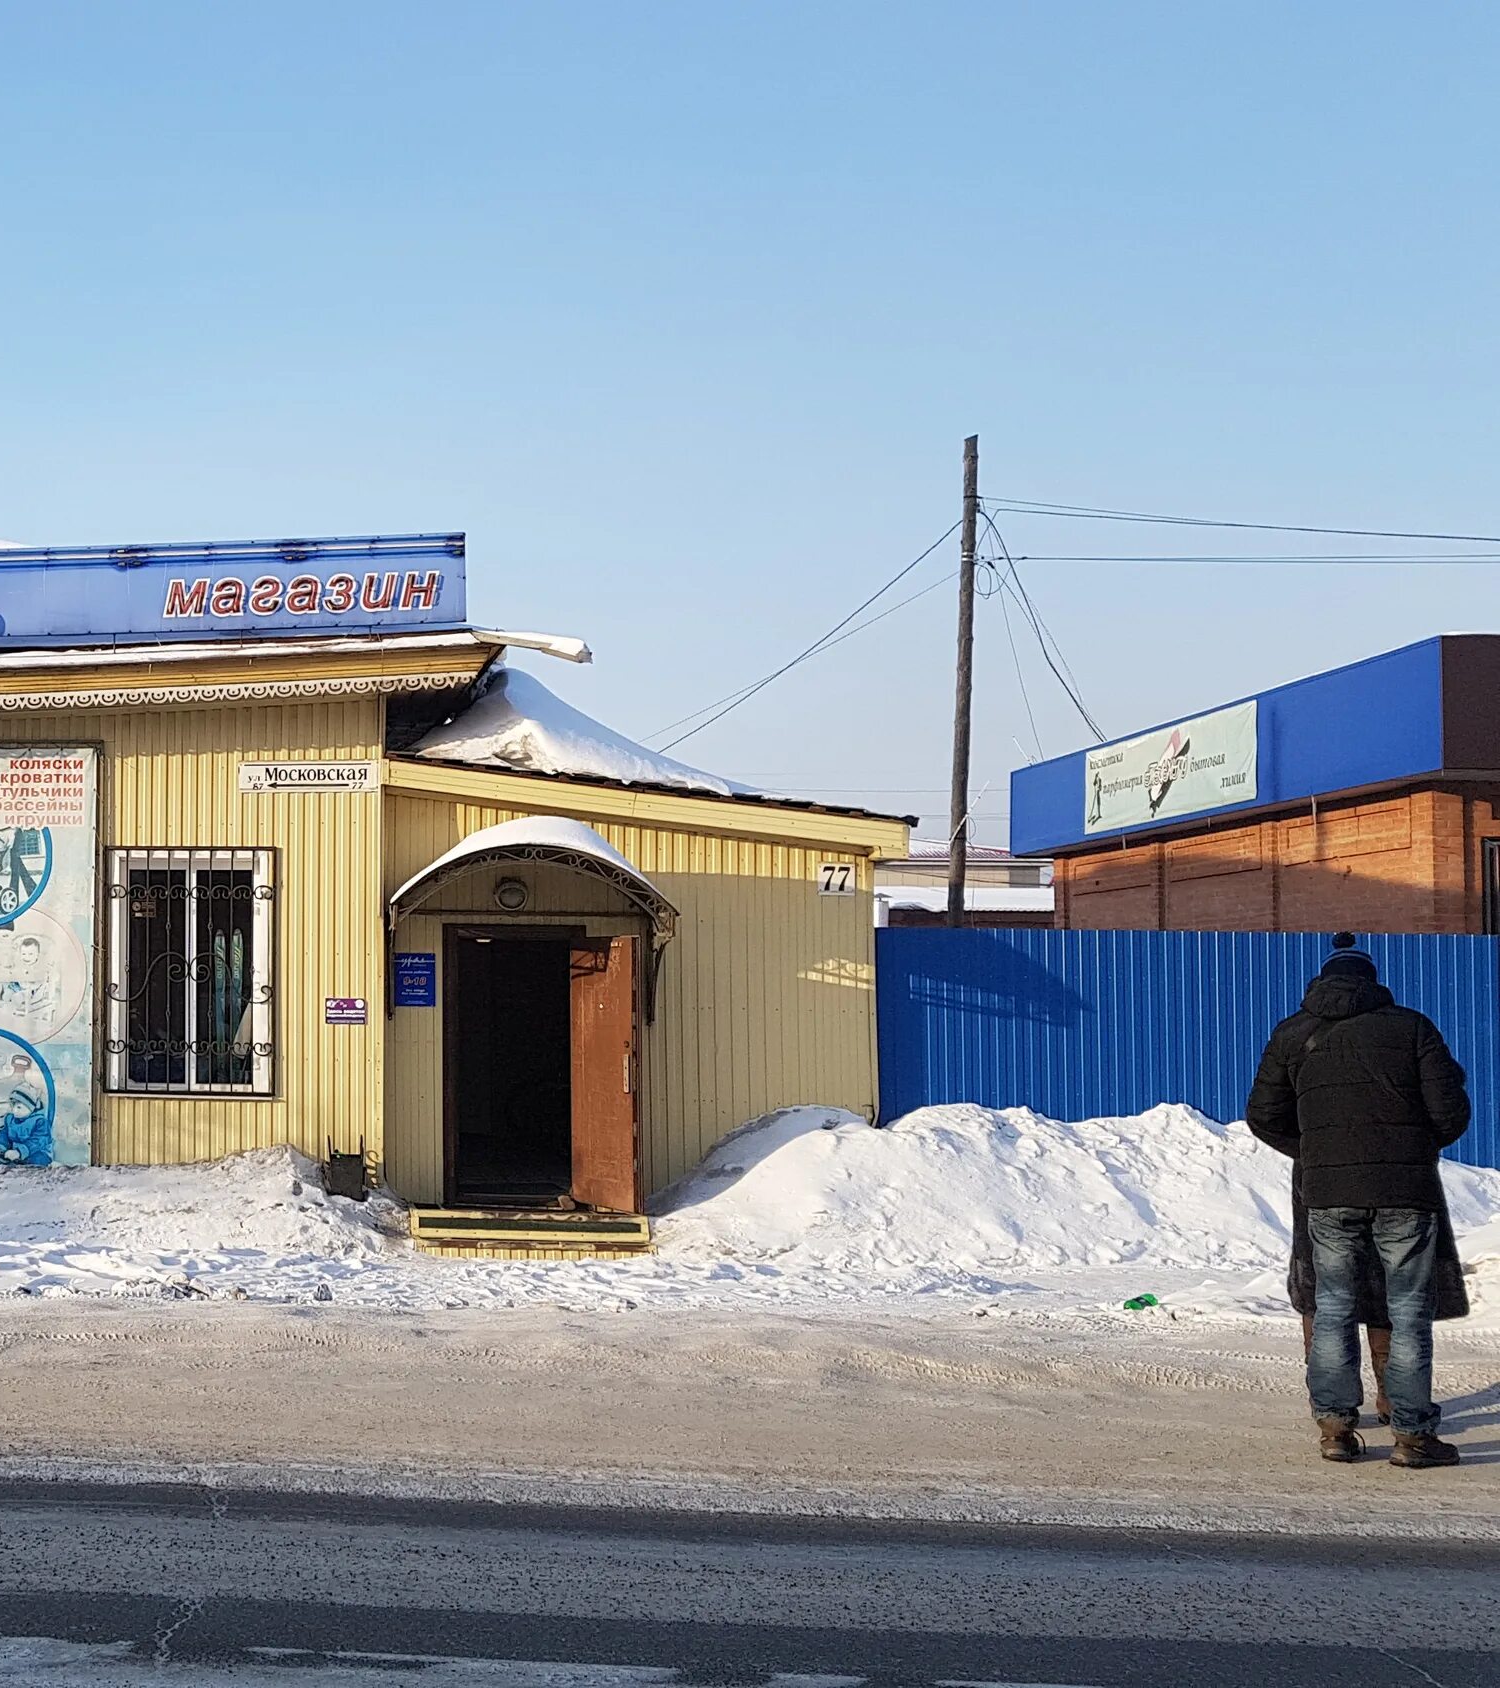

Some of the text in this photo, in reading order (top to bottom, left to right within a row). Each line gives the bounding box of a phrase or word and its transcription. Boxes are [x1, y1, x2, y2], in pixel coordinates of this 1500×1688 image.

[163, 570, 440, 618] магазин
[10, 759, 84, 770] коляски
[0, 773, 84, 786] кроватки
[264, 767, 368, 781] Московская
[4, 815, 83, 827] игрушки
[823, 866, 850, 891] 77
